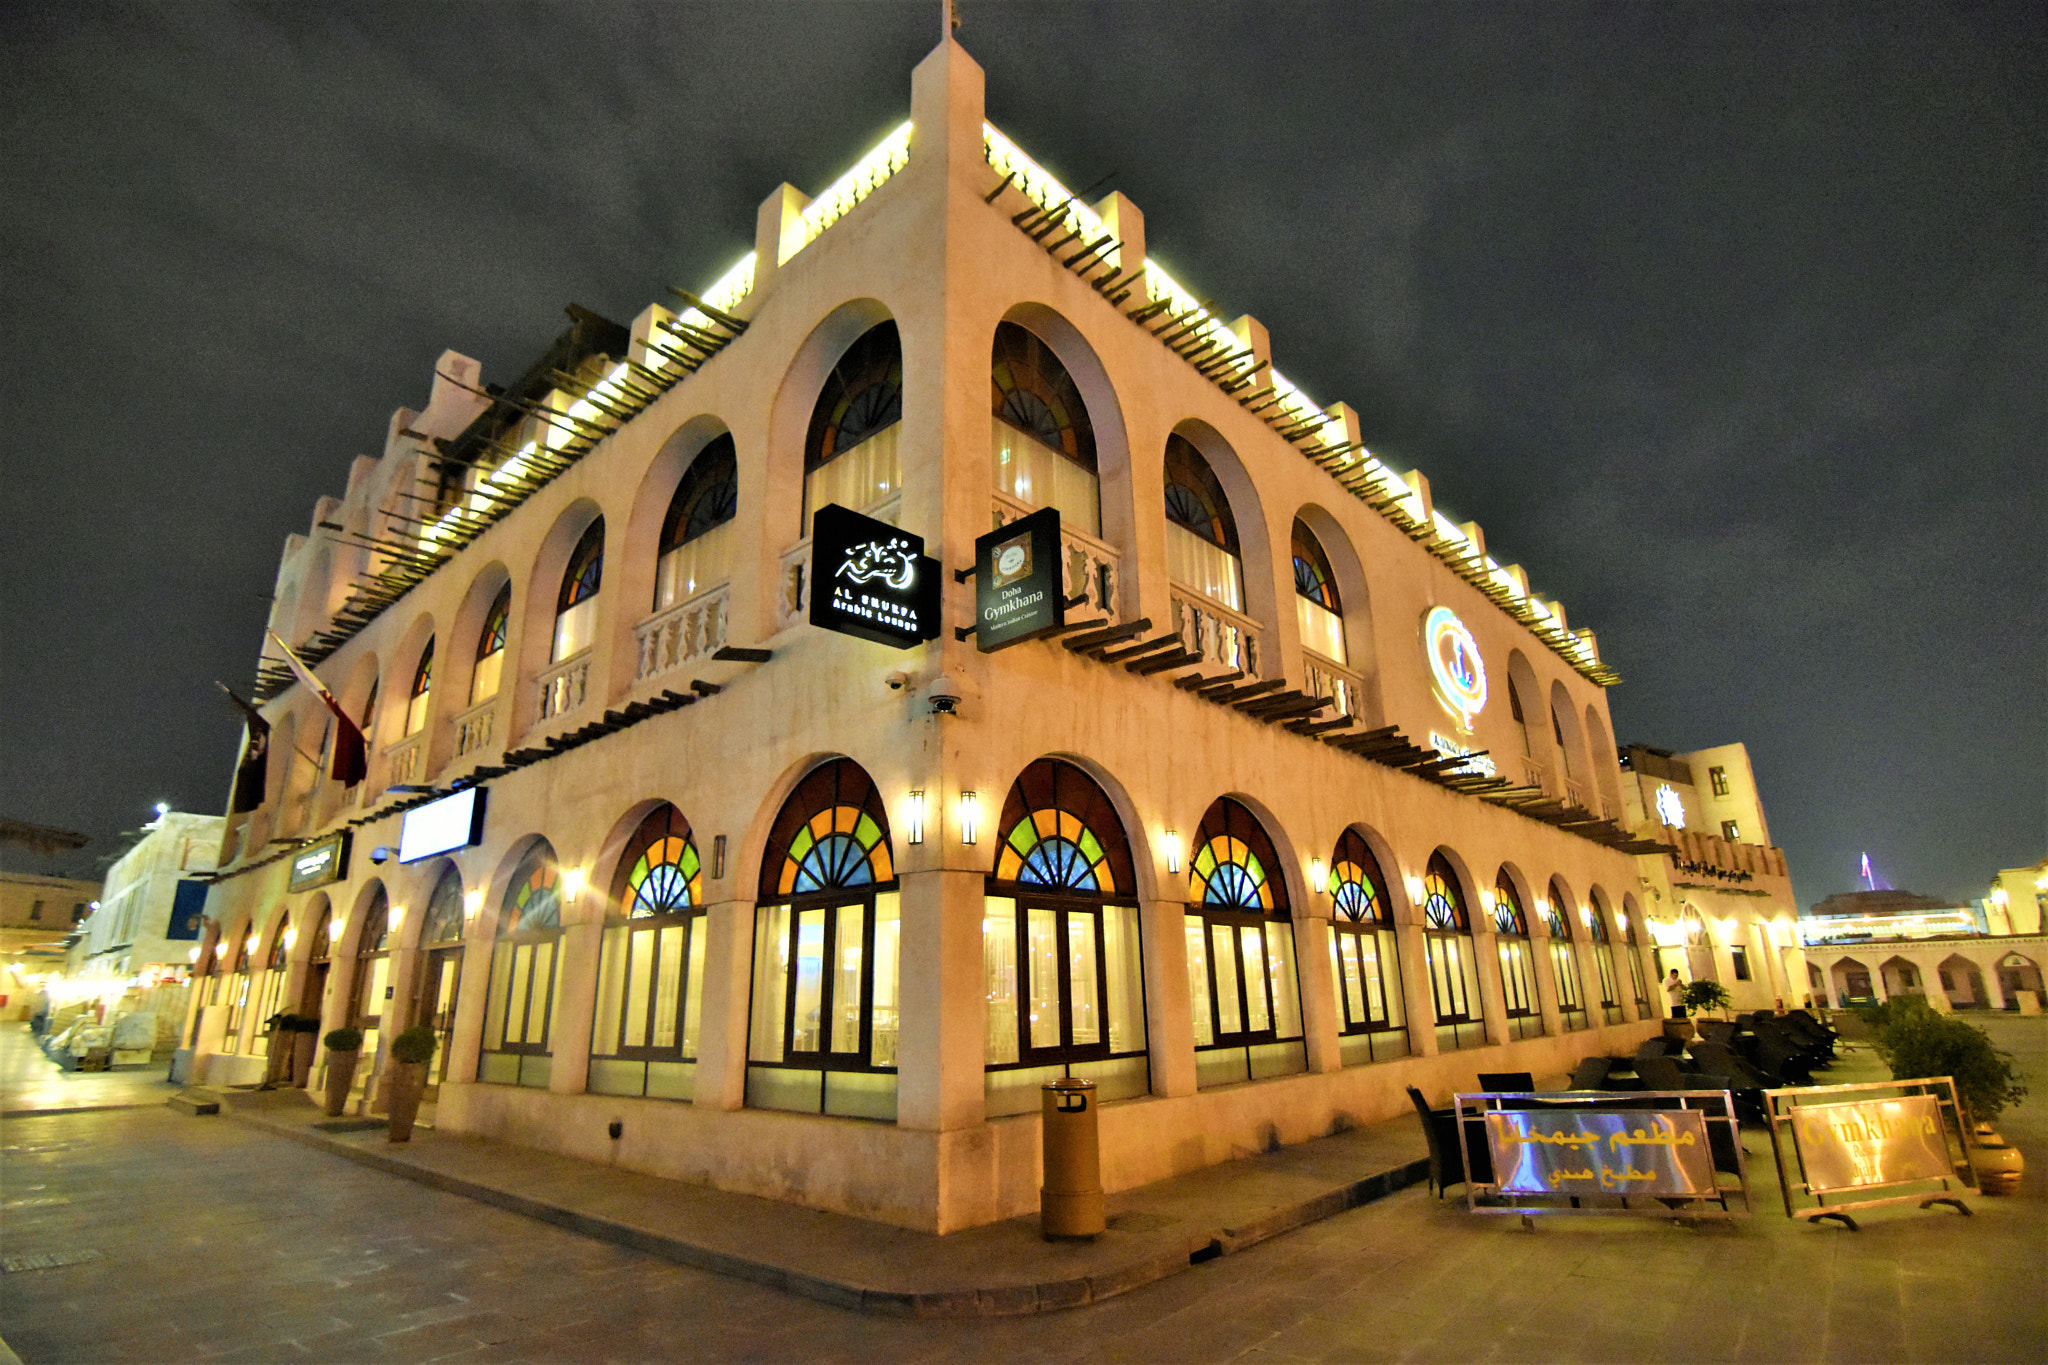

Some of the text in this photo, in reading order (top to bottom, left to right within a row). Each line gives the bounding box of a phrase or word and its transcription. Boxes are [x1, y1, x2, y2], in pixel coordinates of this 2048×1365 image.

[834, 586, 853, 600] AL
[984, 590, 1044, 621] Gymkhana
[1001, 586, 1022, 600] Doha
[1609, 1120, 1696, 1153] مطعم
[1803, 1111, 1938, 1153] Gymkhana
[1601, 1164, 1657, 1188] مطبخ
